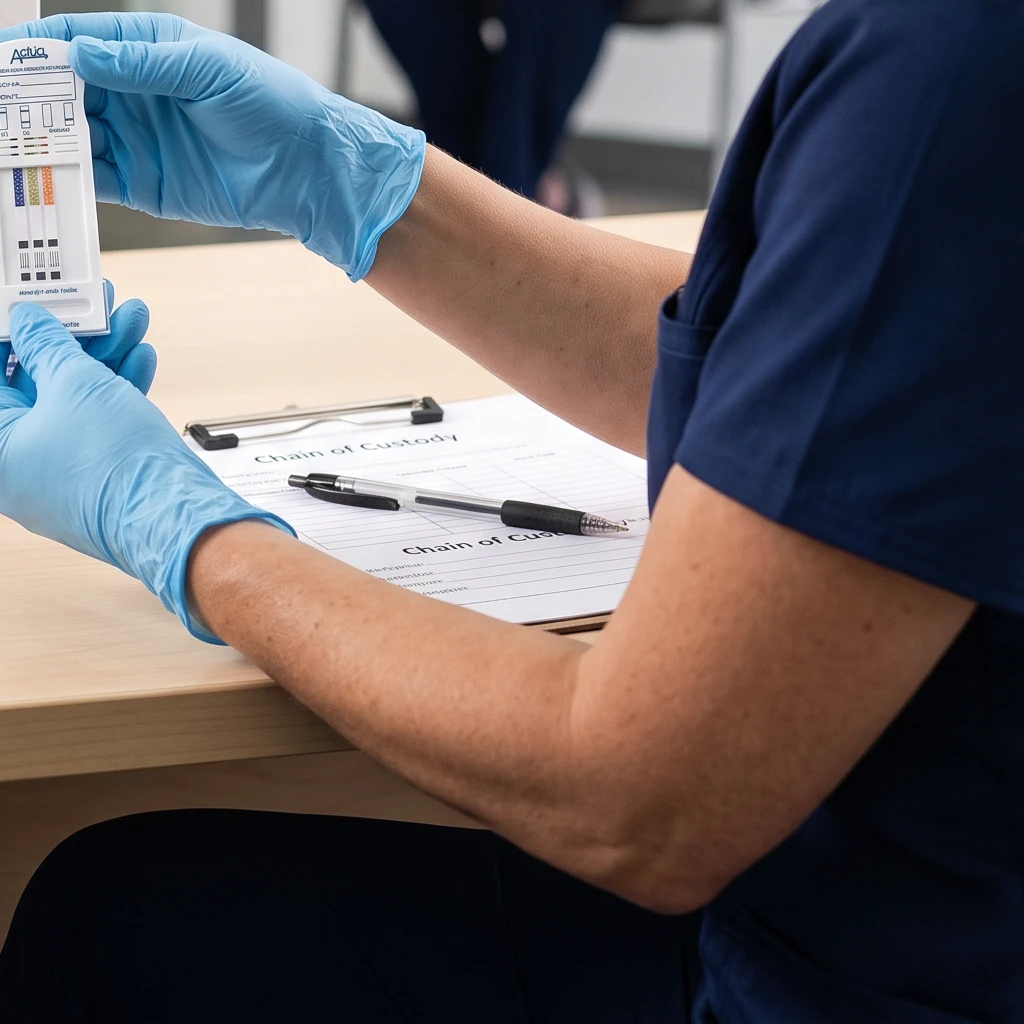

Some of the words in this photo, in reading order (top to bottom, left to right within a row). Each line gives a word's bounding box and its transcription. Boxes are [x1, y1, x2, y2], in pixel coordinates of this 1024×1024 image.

[254, 450, 324, 464] Chain
[331, 445, 353, 455] of
[360, 433, 459, 451] Custody
[402, 539, 473, 555] Chain
[478, 536, 504, 546] of
